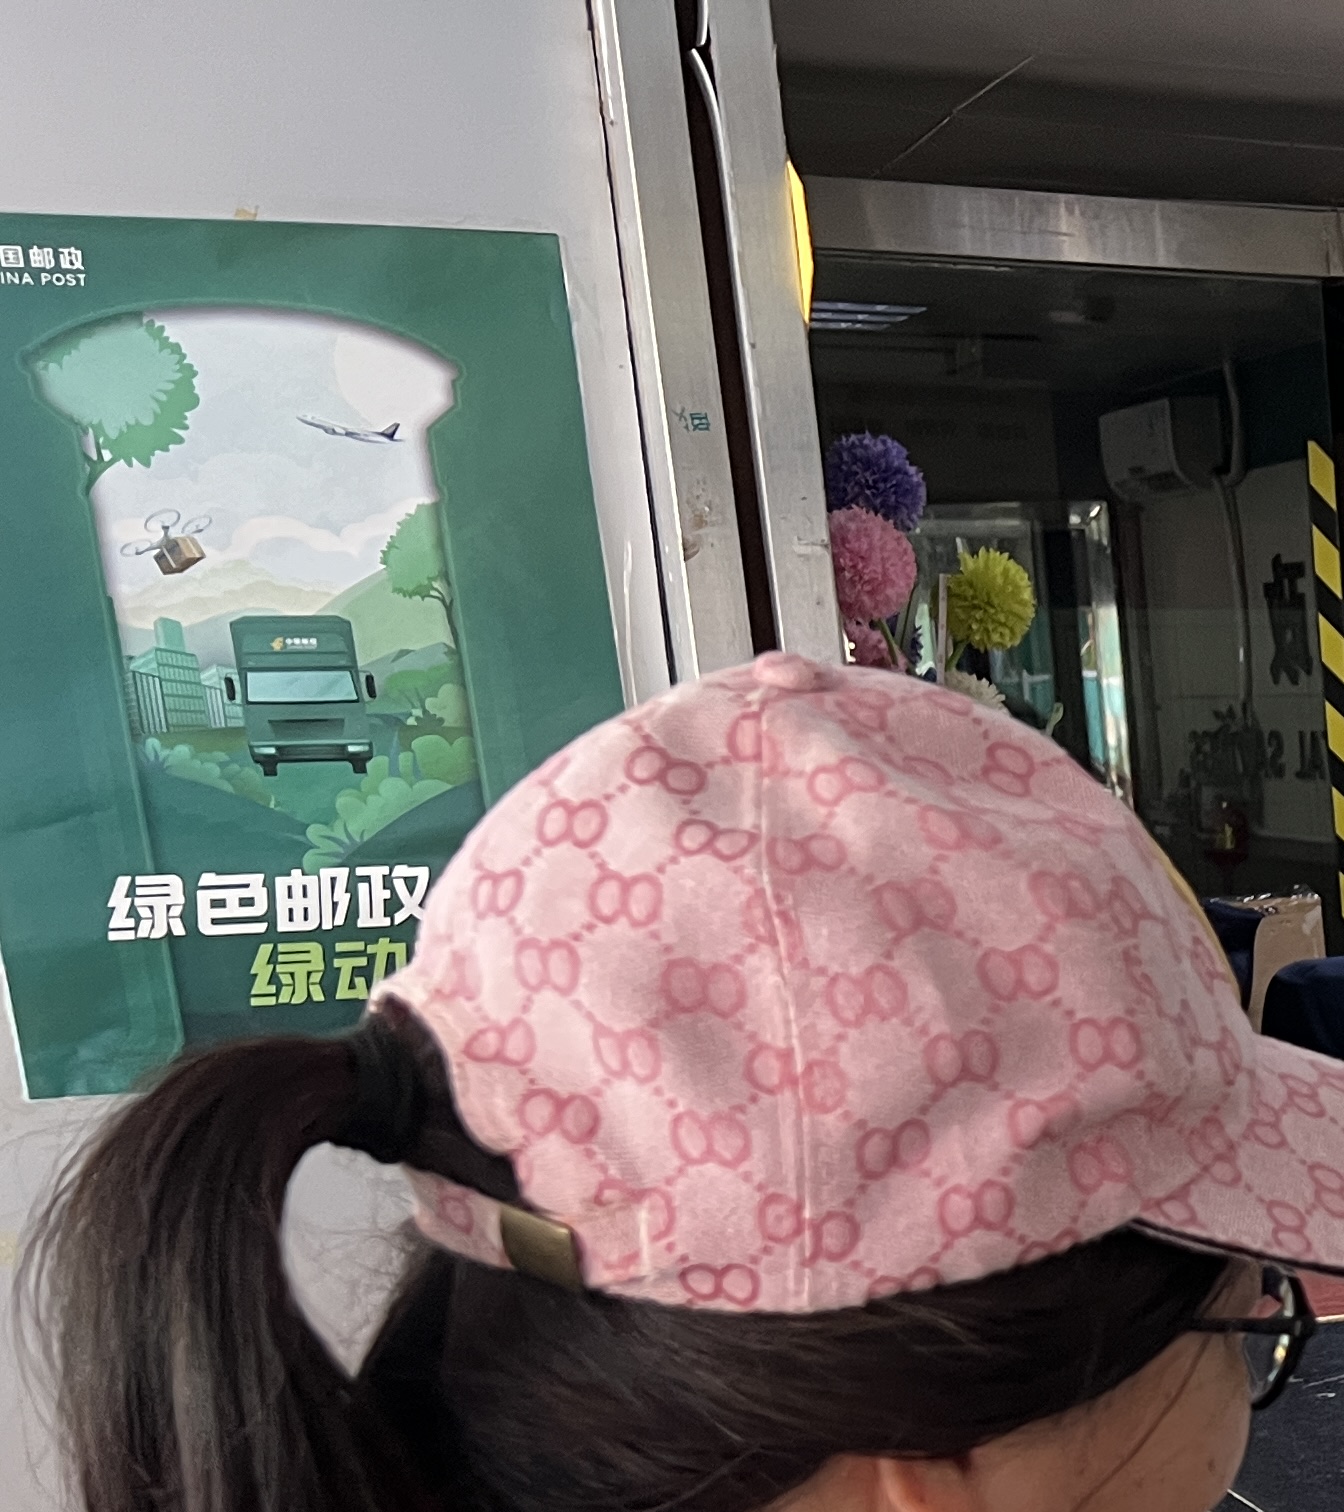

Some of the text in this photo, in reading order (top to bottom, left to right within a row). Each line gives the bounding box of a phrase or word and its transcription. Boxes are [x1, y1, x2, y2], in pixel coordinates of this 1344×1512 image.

[0, 245, 85, 270] 国邮政
[40, 272, 86, 287] POST
[106, 864, 431, 942] 绿色邮政
[249, 937, 409, 1008] 绿动
